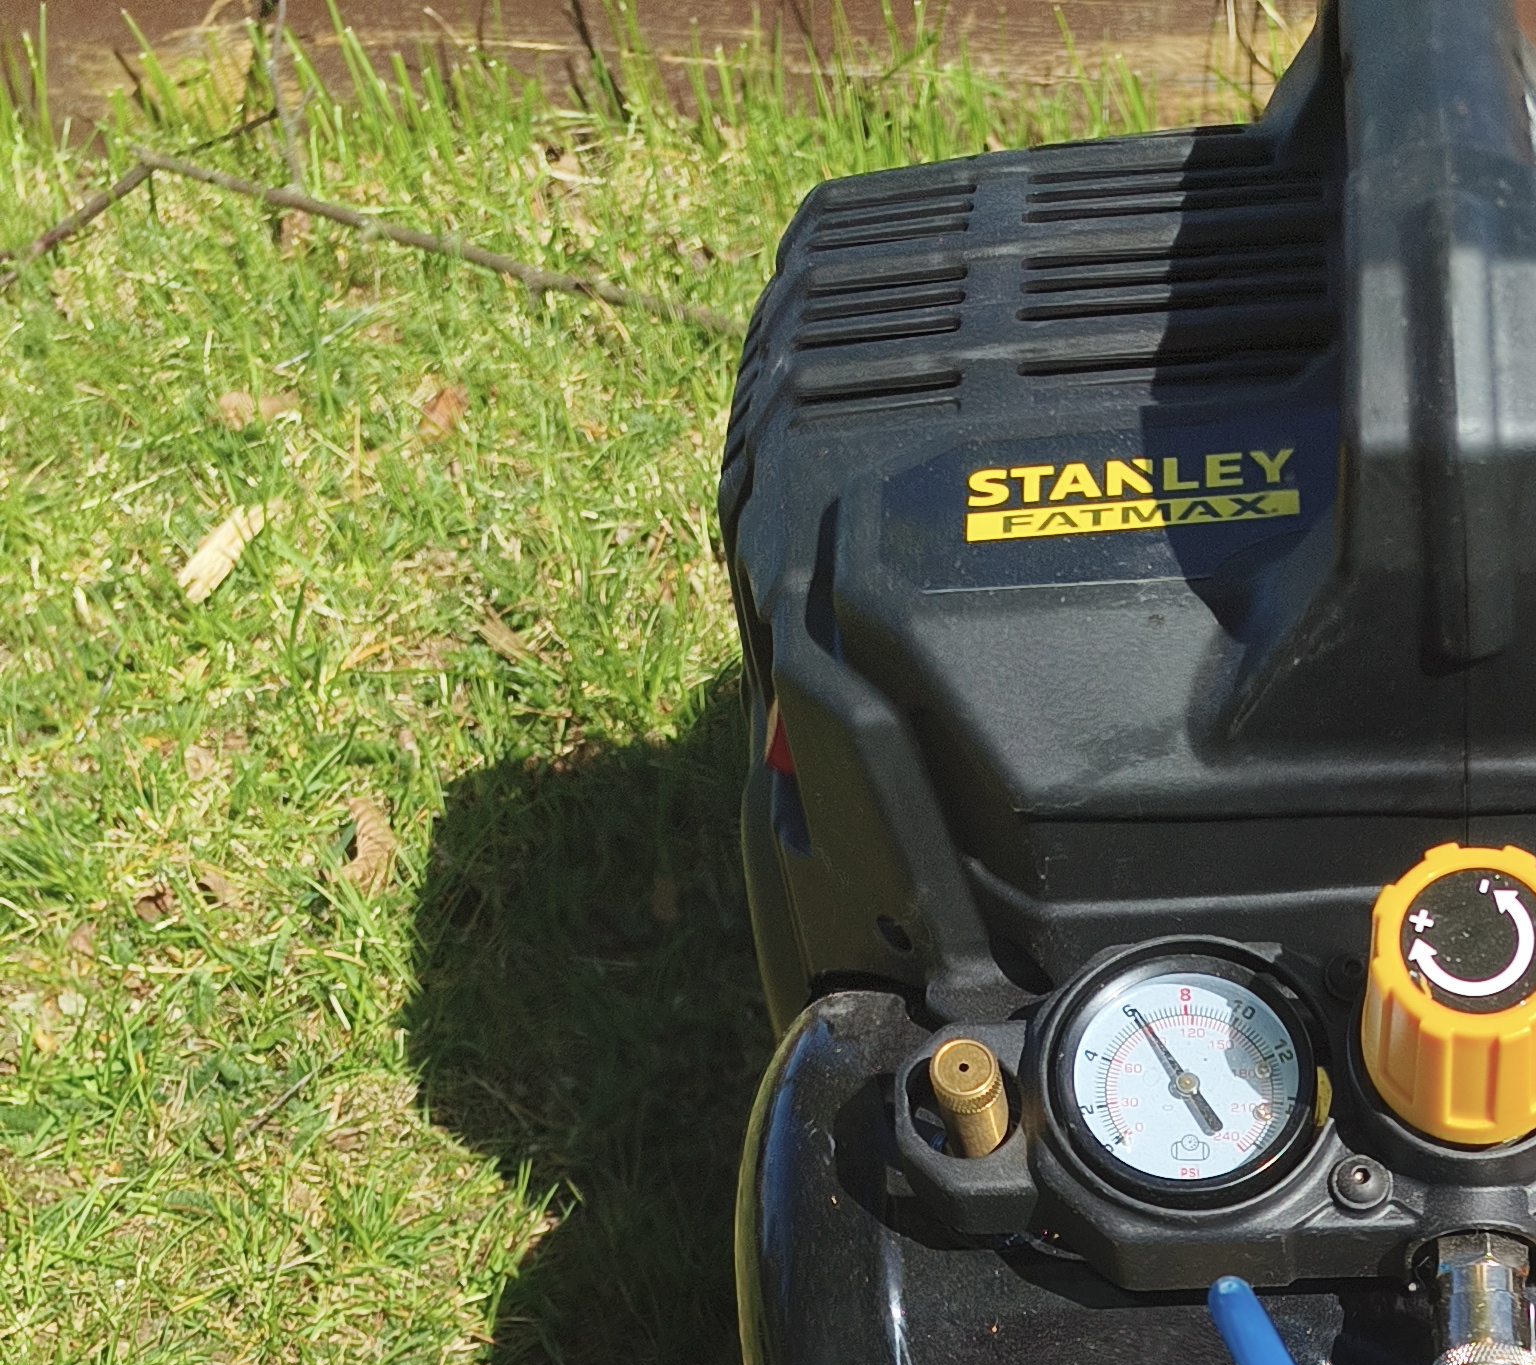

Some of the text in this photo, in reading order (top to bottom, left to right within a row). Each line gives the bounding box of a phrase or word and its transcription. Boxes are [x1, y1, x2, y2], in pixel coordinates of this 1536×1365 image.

[967, 447, 1294, 508] STANLEY
[1002, 494, 1269, 534] FATMAX
[1179, 987, 1192, 1001] 8
[1233, 999, 1256, 1020] 10
[1179, 1027, 1206, 1038] 120
[1207, 1040, 1235, 1050] 150
[1084, 1049, 1099, 1062] 4
[1273, 1038, 1294, 1064] 12
[1124, 1063, 1143, 1074] 60
[1231, 1068, 1256, 1078] 180
[1121, 1096, 1139, 1108] 30
[1135, 1122, 1144, 1132] 0
[1212, 1131, 1240, 1141] 240
[1180, 1167, 1200, 1178] PSI
